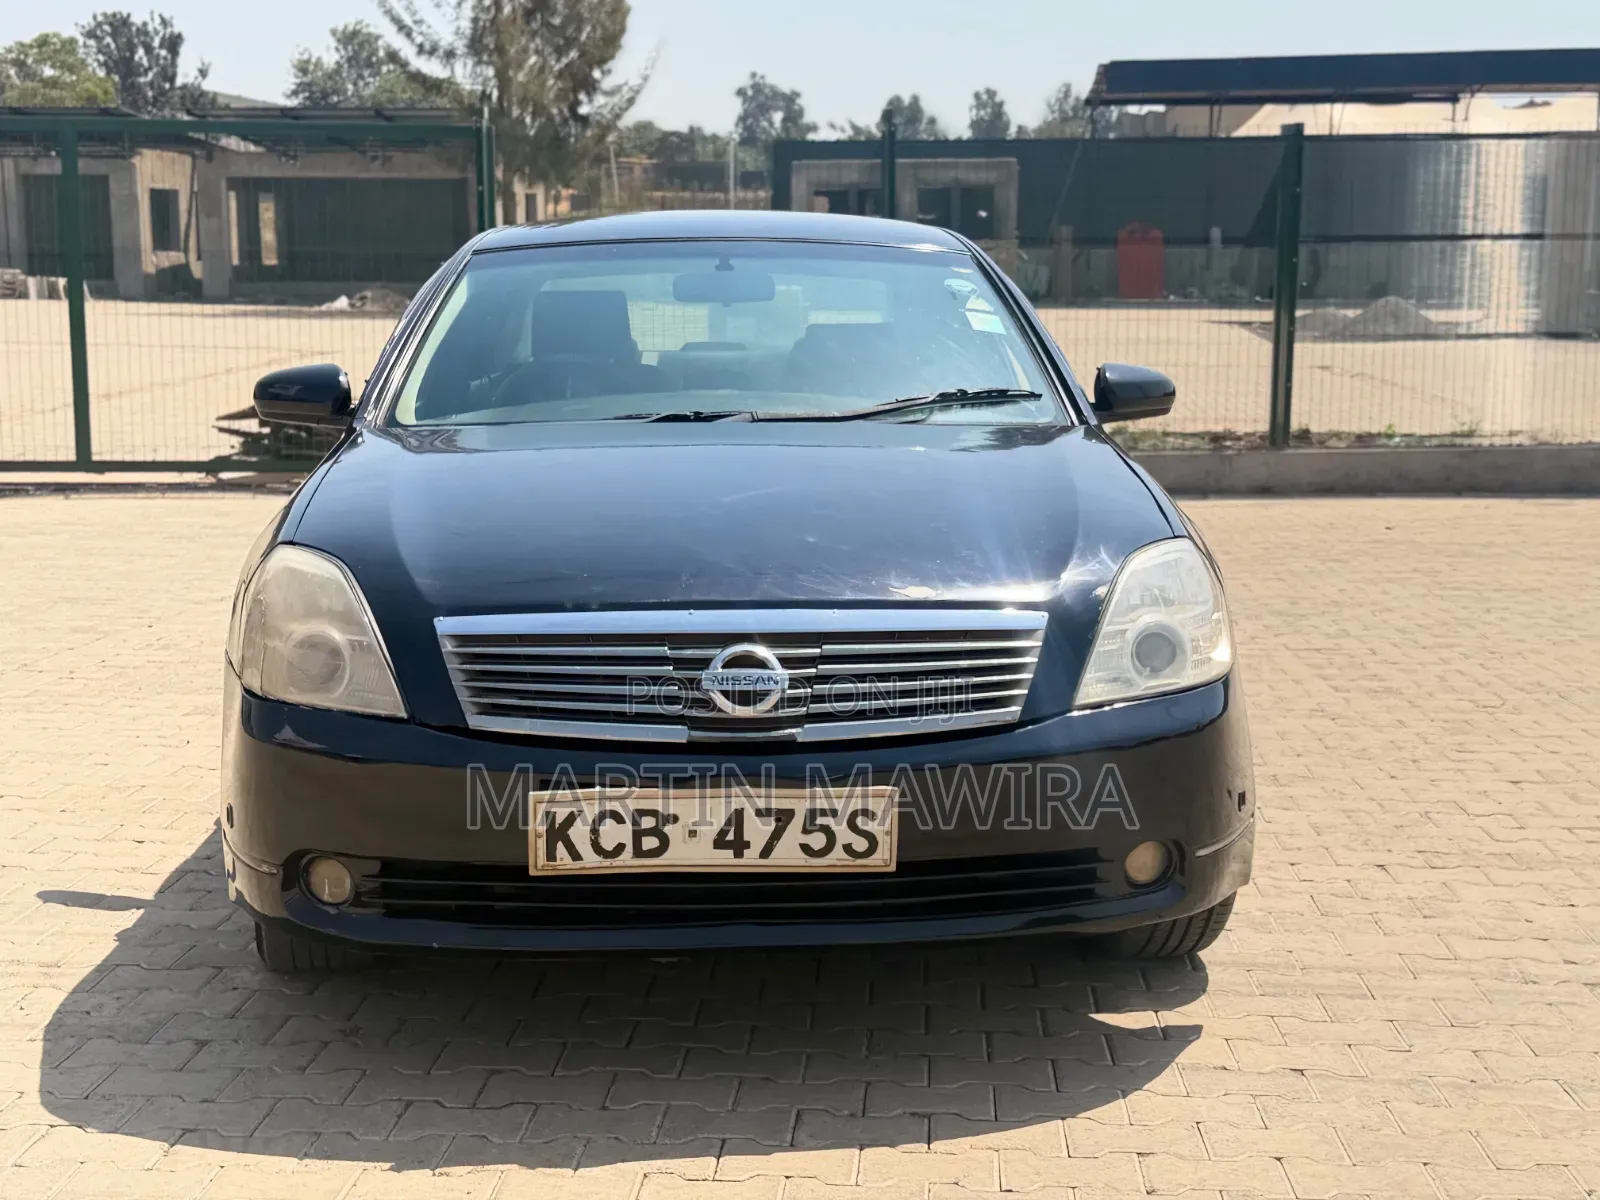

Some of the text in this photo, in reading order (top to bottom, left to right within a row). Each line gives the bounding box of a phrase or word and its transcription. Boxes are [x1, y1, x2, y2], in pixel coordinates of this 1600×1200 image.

[711, 674, 780, 687] NISSAN
[544, 807, 879, 863] KCB 475S
